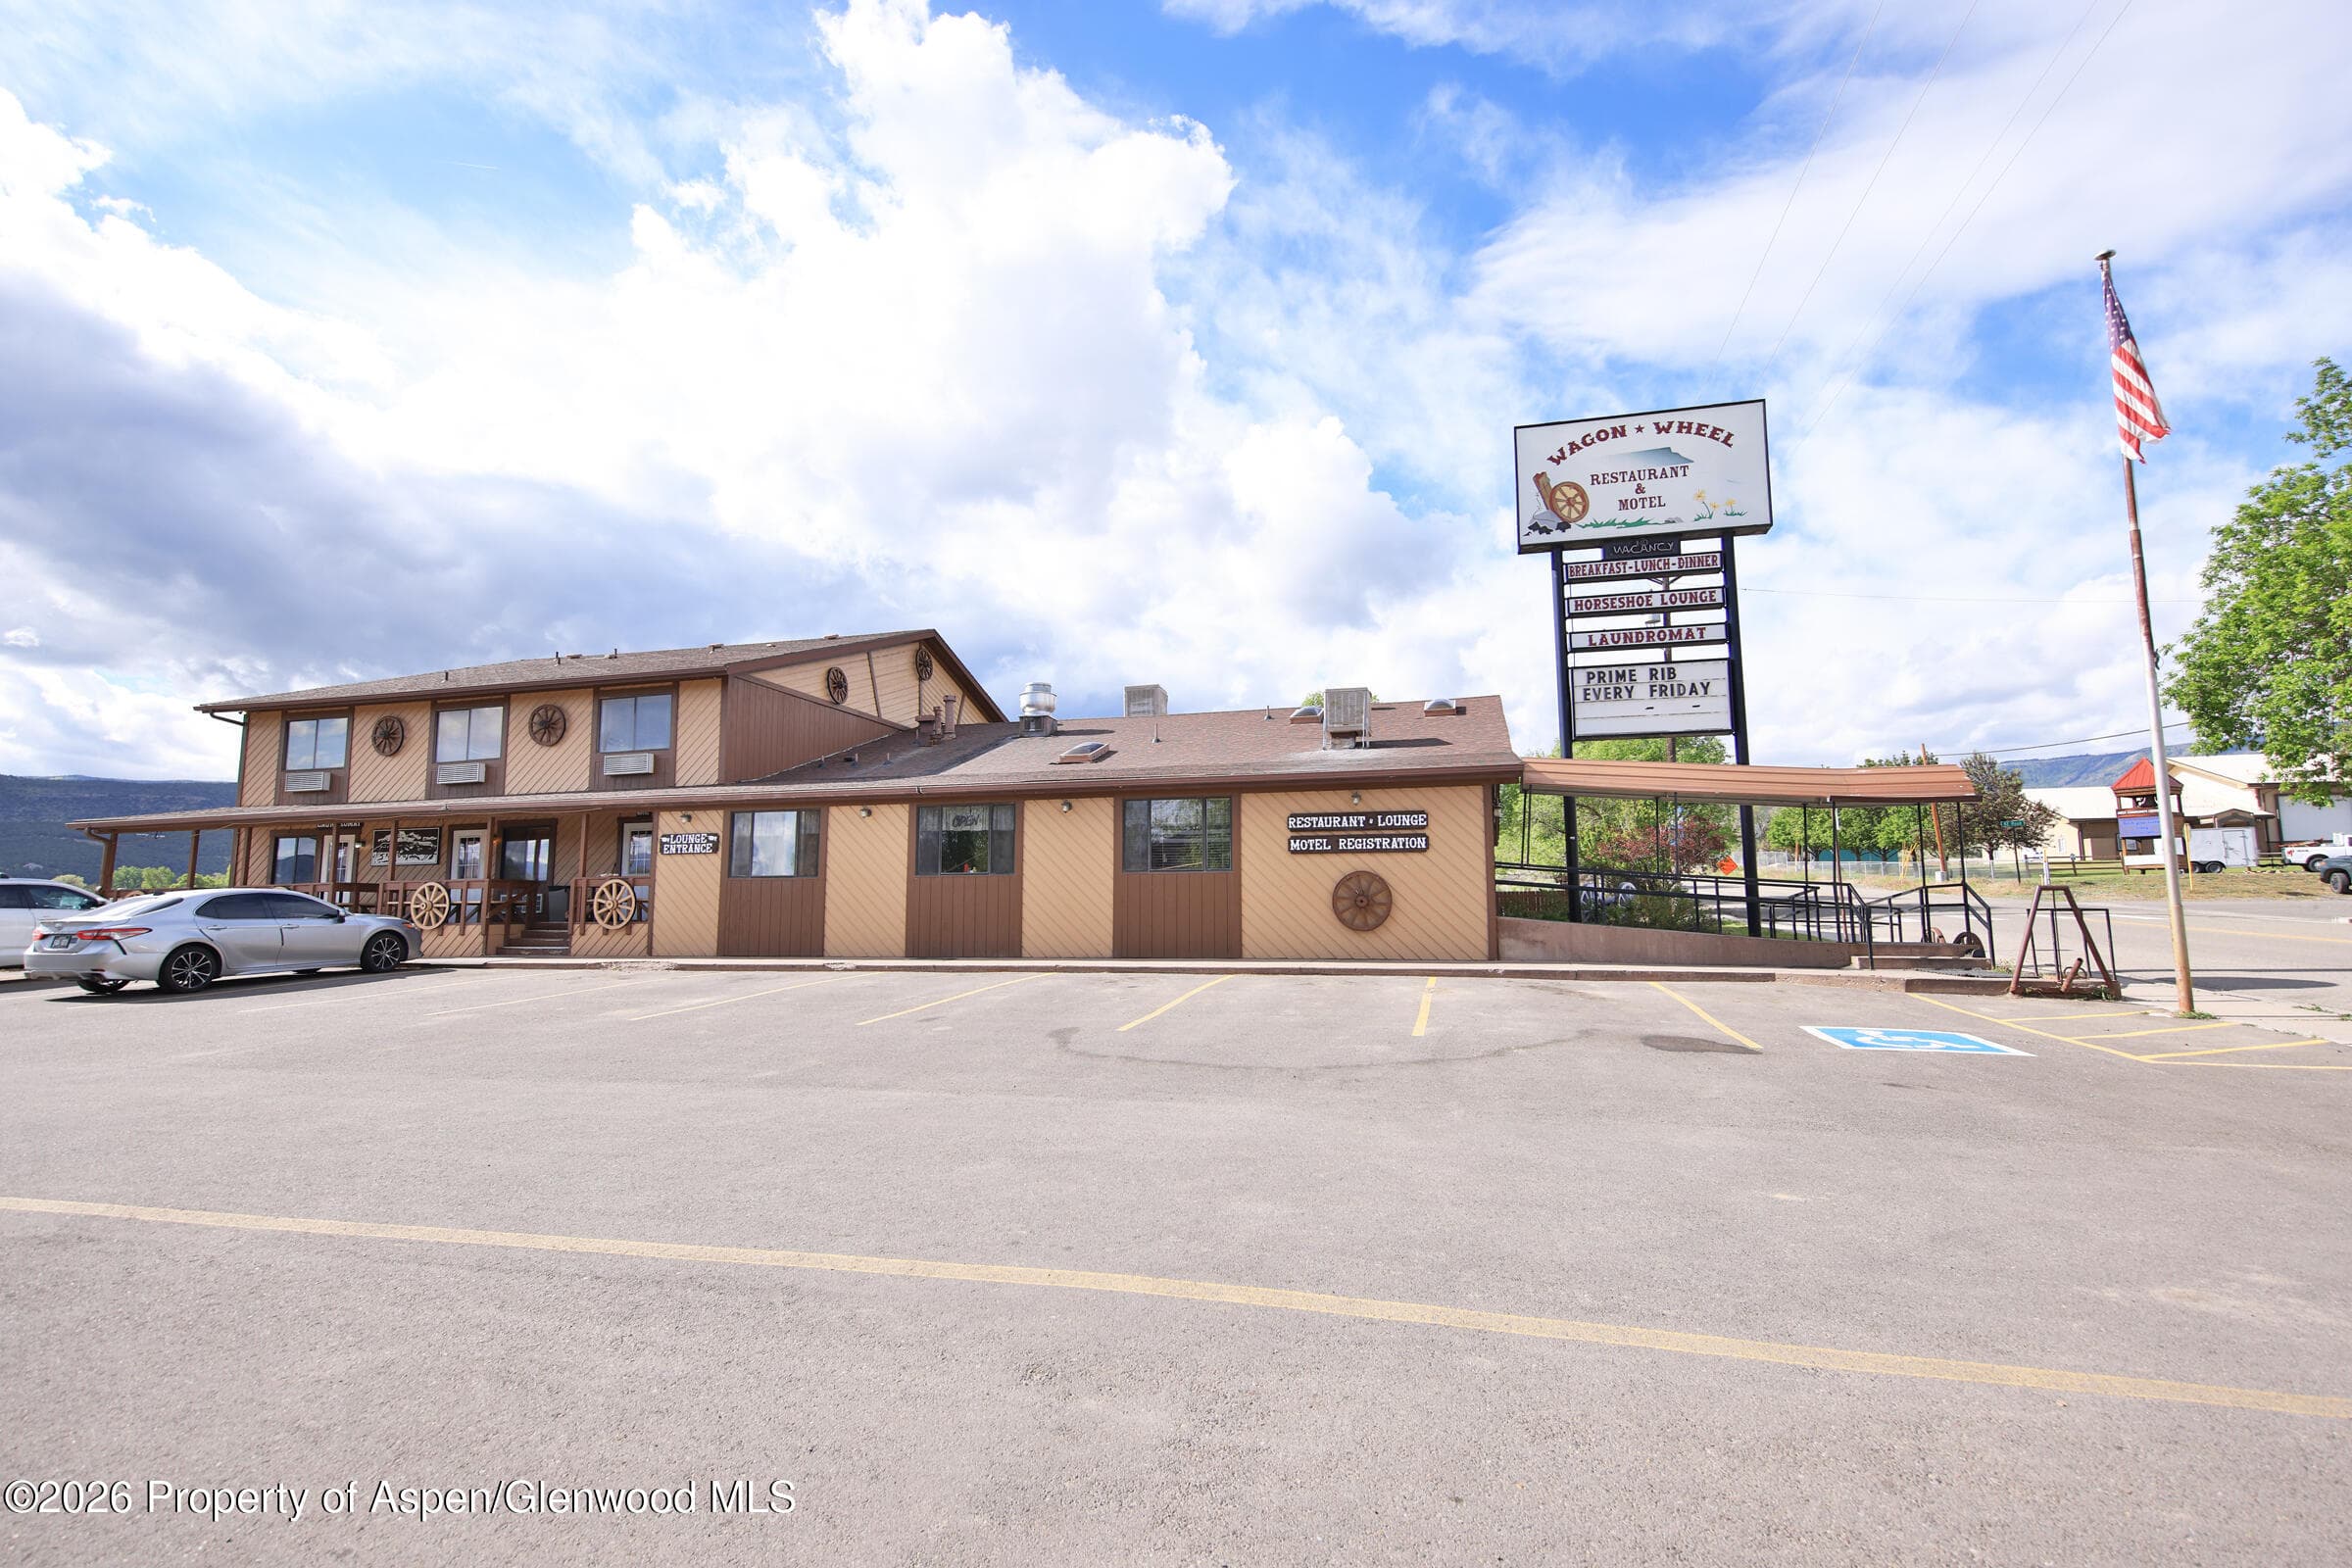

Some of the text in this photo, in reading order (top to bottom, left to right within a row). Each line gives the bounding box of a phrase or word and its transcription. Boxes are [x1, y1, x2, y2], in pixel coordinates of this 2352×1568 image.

[1546, 420, 1735, 466] WAGON WHEEL
[1590, 465, 1690, 485] RESTAURANT
[1635, 483, 1646, 494] &
[1618, 496, 1666, 511] MOTEL
[1613, 542, 1674, 555] VACANCY
[1574, 590, 1717, 612] HORSESHOE LOUNGE
[1588, 627, 1706, 647] LAUNDROMAT
[1587, 666, 1677, 684] PRIME RIB
[1583, 681, 1711, 702] EVERY FRIDAY
[1288, 813, 1427, 829] RESTAURANT LOUNGE
[670, 833, 708, 844] LOUNGE
[1290, 836, 1427, 851] MOTEL REGISTRATION
[662, 843, 713, 855] ENTRANCE
